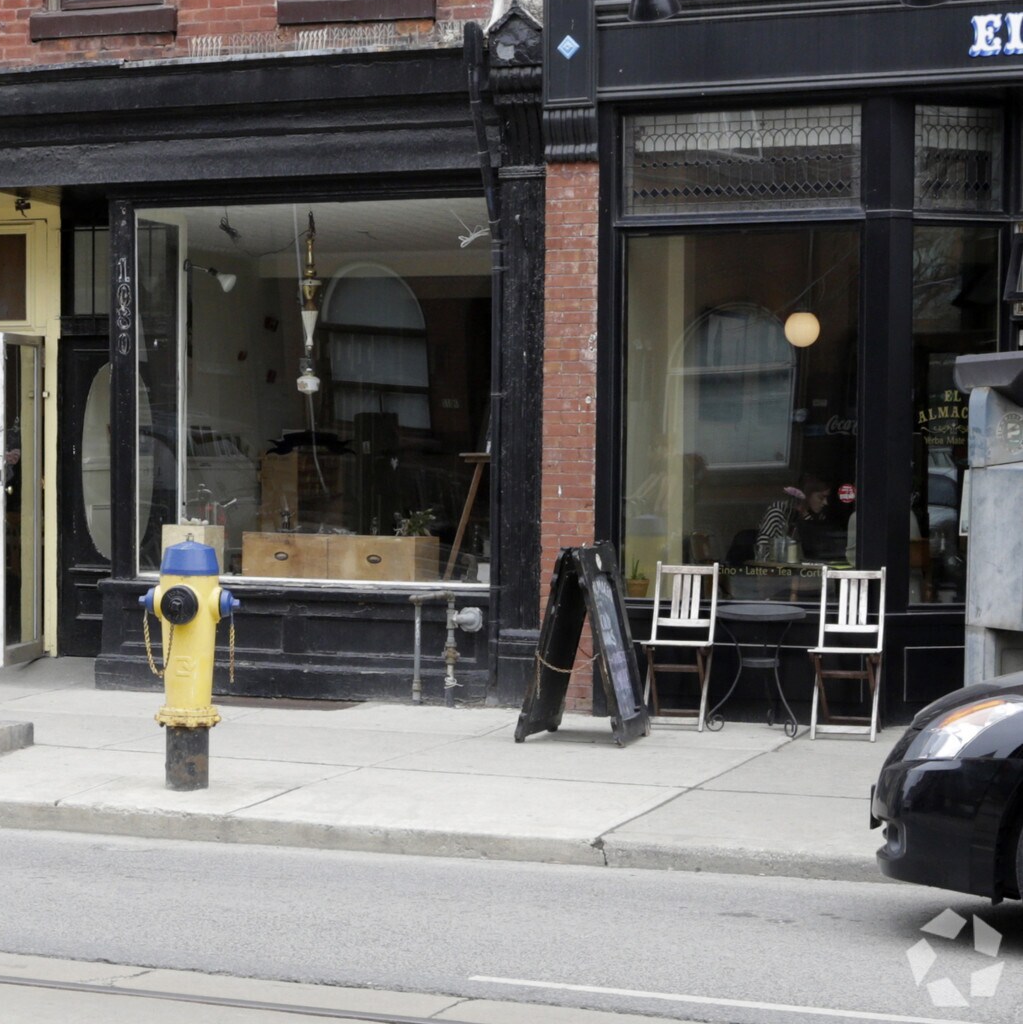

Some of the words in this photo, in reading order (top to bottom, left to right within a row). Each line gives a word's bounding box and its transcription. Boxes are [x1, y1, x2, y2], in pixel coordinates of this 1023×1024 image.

[944, 390, 961, 402] EL
[924, 437, 943, 445] Yerba
[746, 566, 768, 576] Latte
[778, 566, 792, 576] Tea
